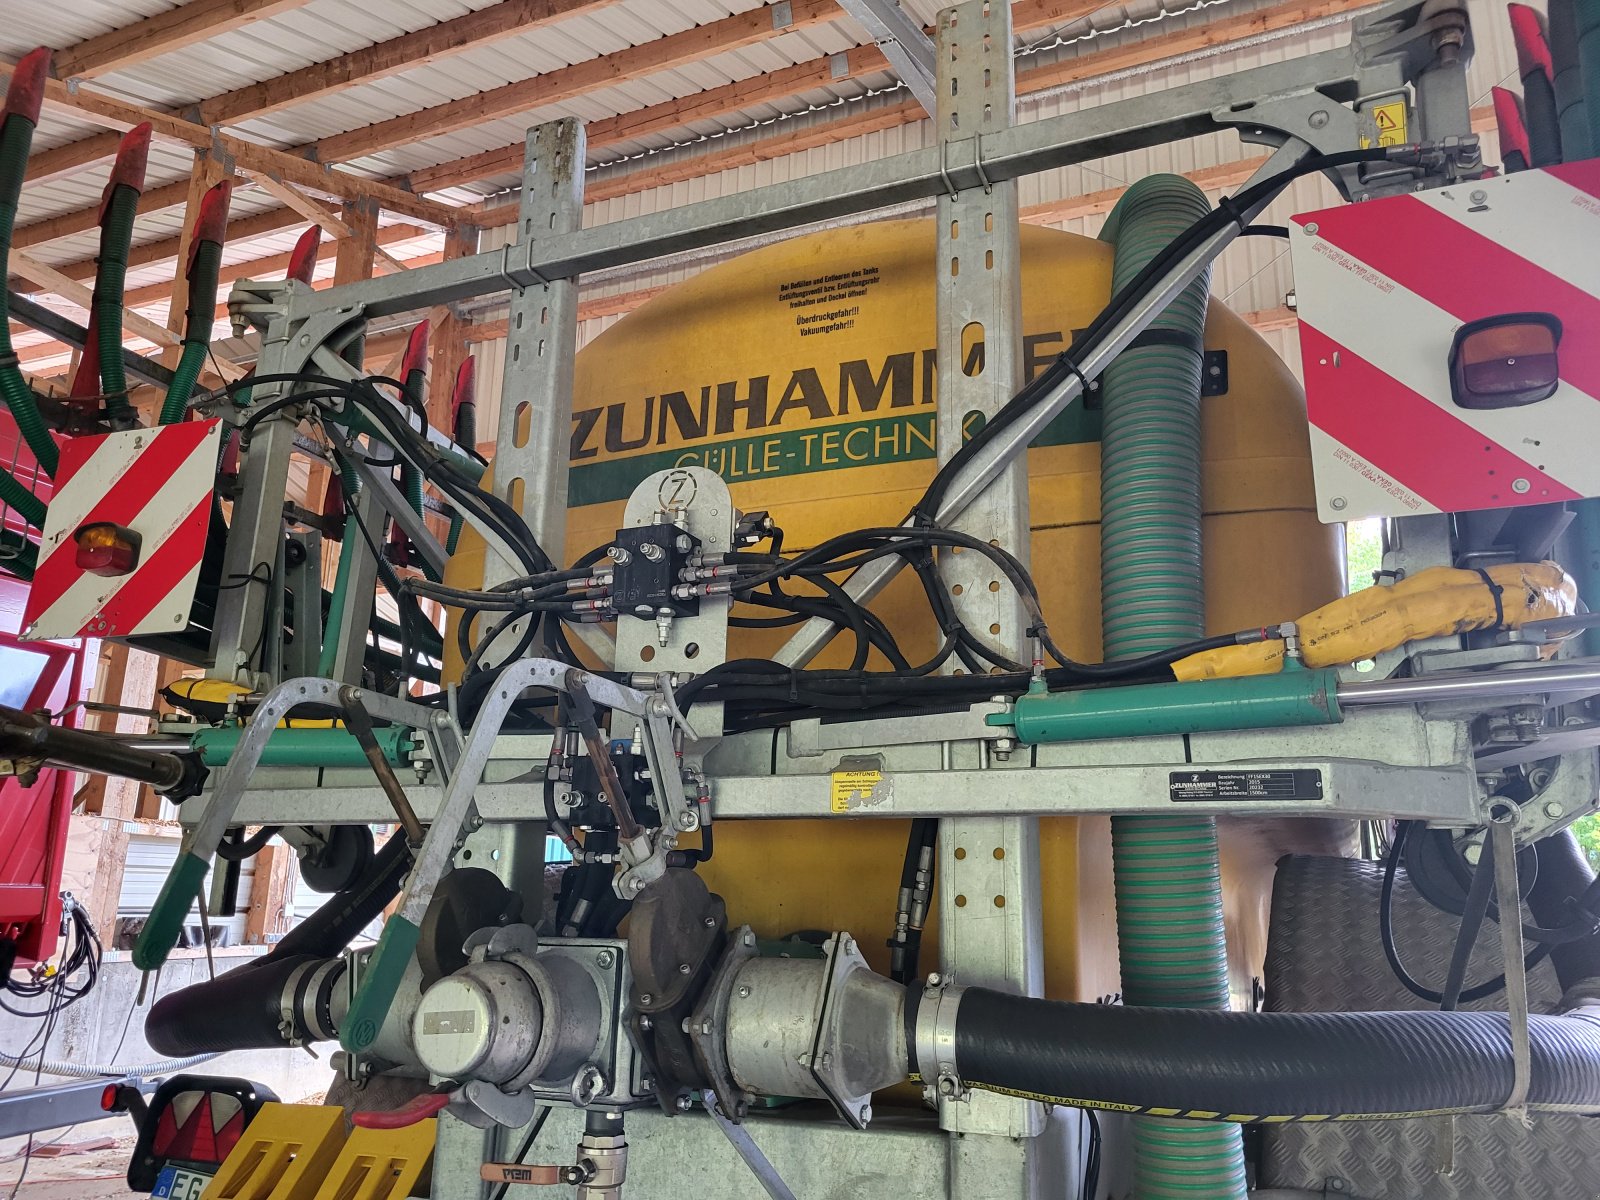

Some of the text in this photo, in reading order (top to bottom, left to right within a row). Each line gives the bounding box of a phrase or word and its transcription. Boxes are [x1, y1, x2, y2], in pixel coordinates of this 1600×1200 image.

[779, 286, 823, 302] Entlüftungsventil
[837, 276, 880, 290] Entlüftungsrohr
[781, 267, 879, 292] Bei Befüllen und Entleeren des Tanks
[789, 288, 868, 309] freihalten und Deckel öffnen!
[796, 306, 859, 326] Überdruckgefahr!!!
[800, 319, 854, 337] Vakuumgefahr!!!
[1053, 1097, 1087, 1107] MADE
[1102, 1102, 1136, 1112] ITALY
[158, 1187, 166, 1197] D
